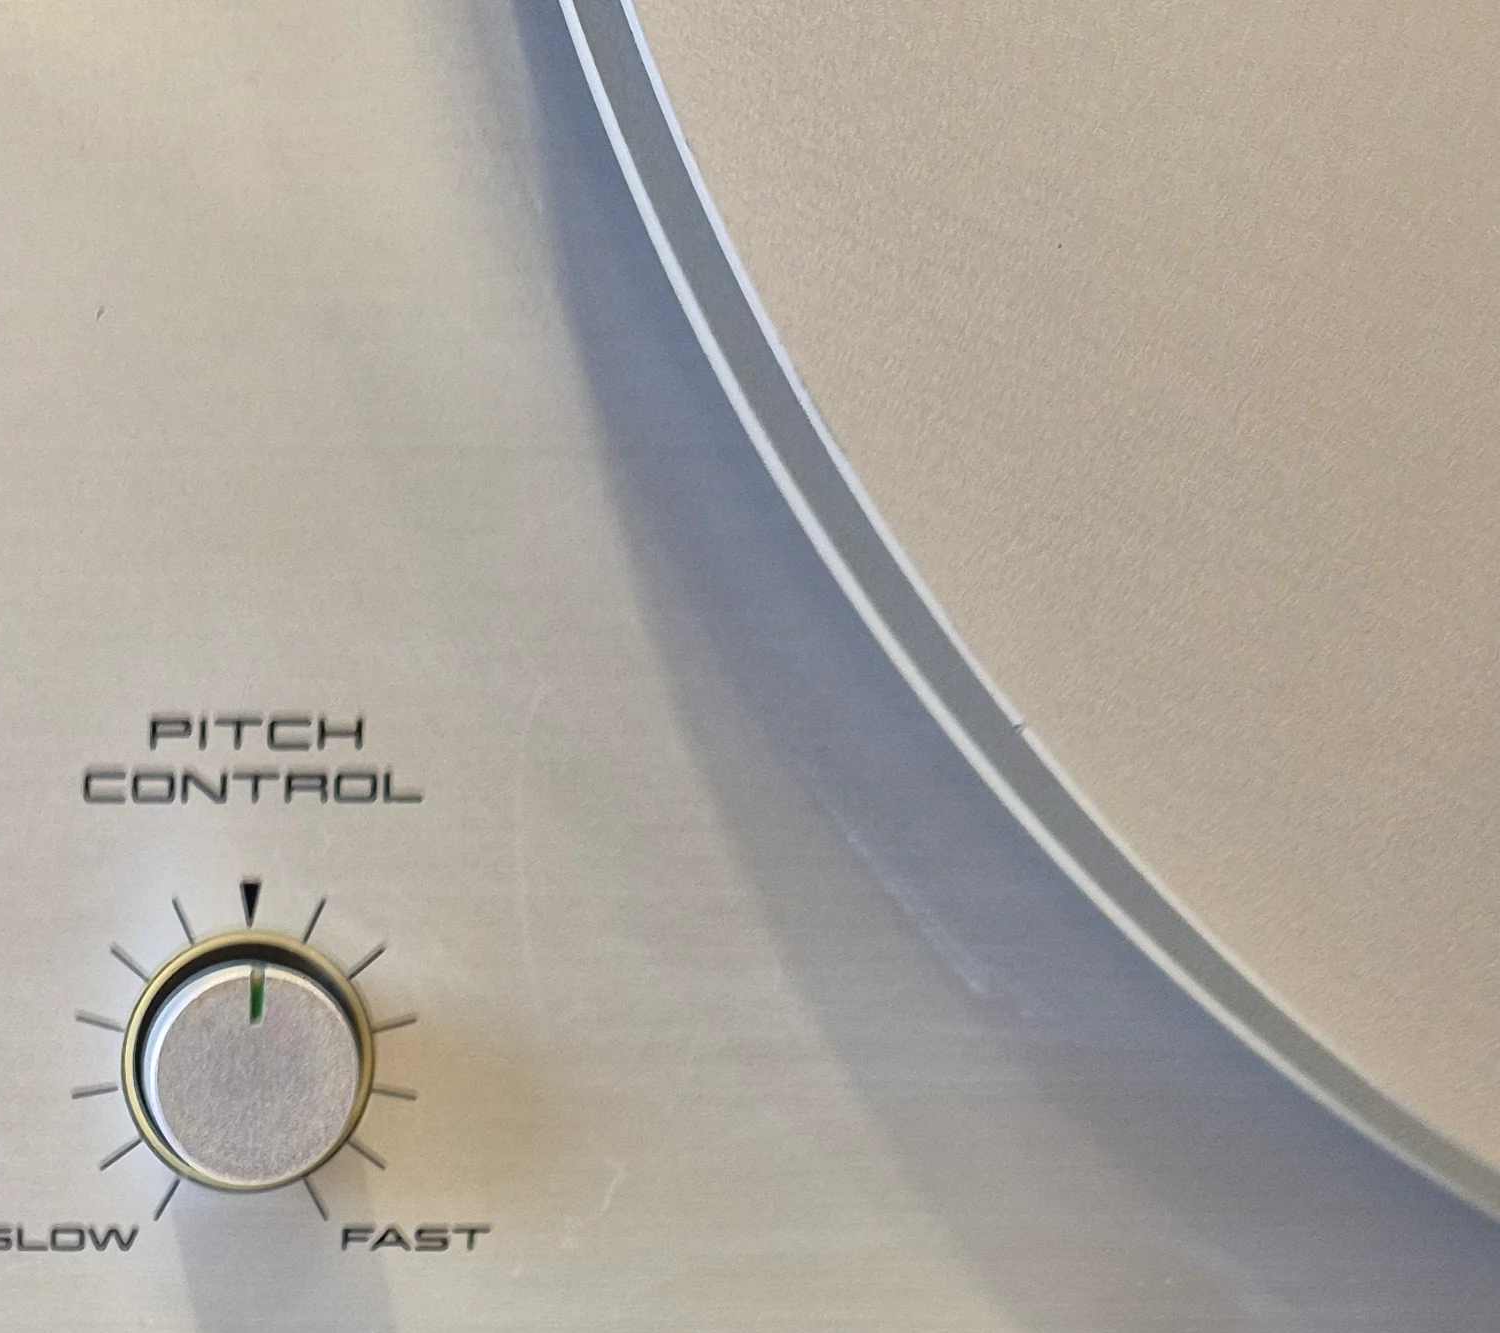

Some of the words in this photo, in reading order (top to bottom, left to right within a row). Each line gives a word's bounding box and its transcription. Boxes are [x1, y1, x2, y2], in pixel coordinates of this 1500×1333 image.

[149, 714, 365, 750] PITCH
[83, 767, 423, 804] CONTROL
[341, 1224, 492, 1251] FAST
